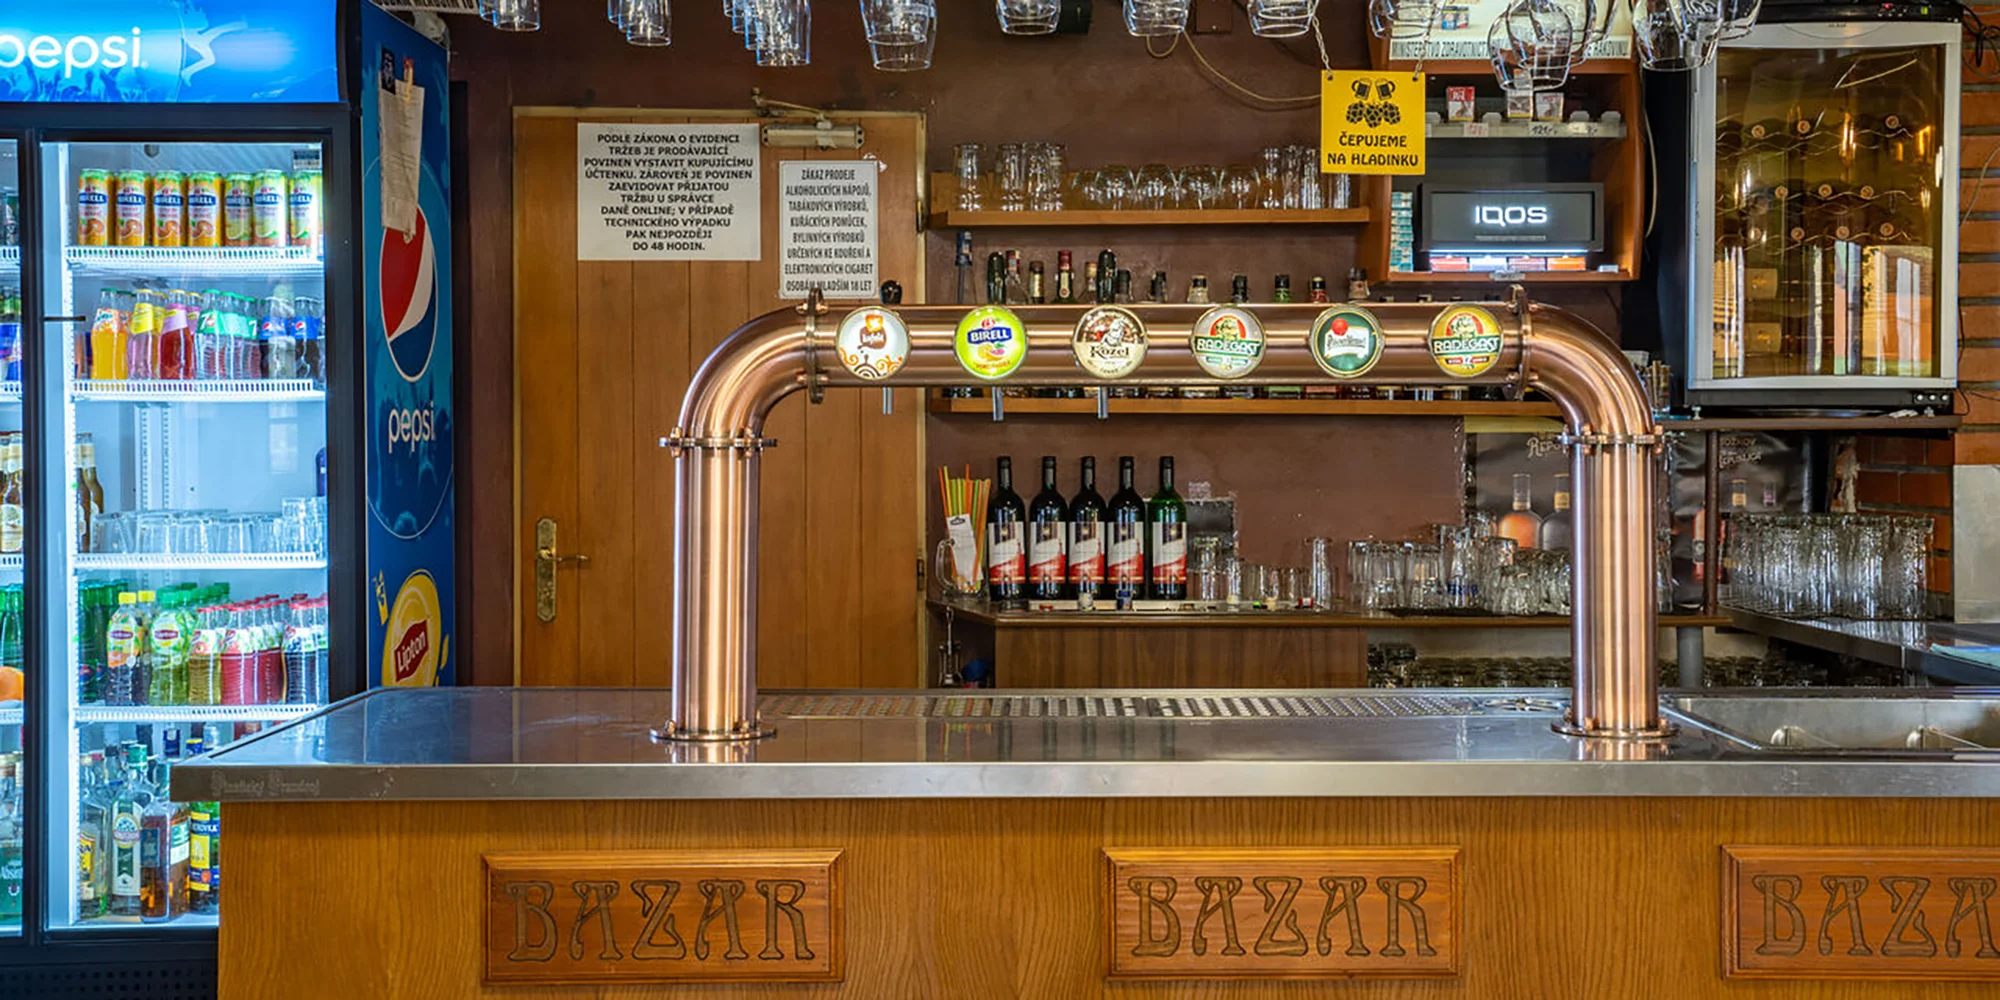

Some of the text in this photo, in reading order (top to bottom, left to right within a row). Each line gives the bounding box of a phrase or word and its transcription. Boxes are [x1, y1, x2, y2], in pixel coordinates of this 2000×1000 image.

[597, 132, 740, 143] PODLE ZÁKONA O EVIDENCI
[1339, 131, 1407, 147] ČEPUJEME
[609, 144, 729, 155] TRŽEB JE PRODÁVAJÍCÍ
[584, 156, 753, 167] POVINEN VYSTAVIT KUPUJÍCÍMU
[1327, 153, 1418, 166] NA HLADINKU
[585, 168, 752, 179] ÚČTENKU. ZÁROVEŇ JE POVINEN
[801, 168, 855, 180] ZÁKAZ PRODEJE
[608, 180, 729, 191] ZAEVIDOVAT PŘIJATOU
[785, 183, 871, 197] ALKOHOLICKÝCH NÁPOJŮ,
[621, 192, 714, 203] TRŽBU U SPRÁVCE
[600, 204, 734, 216] DANĚ ONLINE; V PŘÍPADĚ
[788, 199, 833, 211] TABÁKOVÝCH
[604, 216, 731, 227] TECHNICKÉHO VÝPADKU
[790, 214, 868, 228] KUŘÁCKÝCH POMŮCEK,
[1475, 206, 1548, 227] IQOS
[626, 228, 712, 239] PAK NEJPOZDĚJI
[793, 230, 865, 243] BYLINNÝCH VÝROBKŮ
[633, 242, 705, 250] DO 48 HODIN.
[787, 246, 871, 259] URČENÝCH KE KOUŘENÍ A
[785, 262, 873, 274] ELEKTRONICKÝCH CIGARET
[851, 281, 858, 291] 18
[861, 281, 872, 291] LET
[971, 329, 1009, 341] BIRELL
[1197, 339, 1260, 355] RADEGAST
[1434, 337, 1500, 353] RADEGAST
[1090, 346, 1129, 359] Kozel
[388, 400, 434, 454] pepsi
[397, 631, 426, 672] Lipton
[503, 879, 816, 962] BAZAR
[1127, 875, 1438, 957] BAZAR
